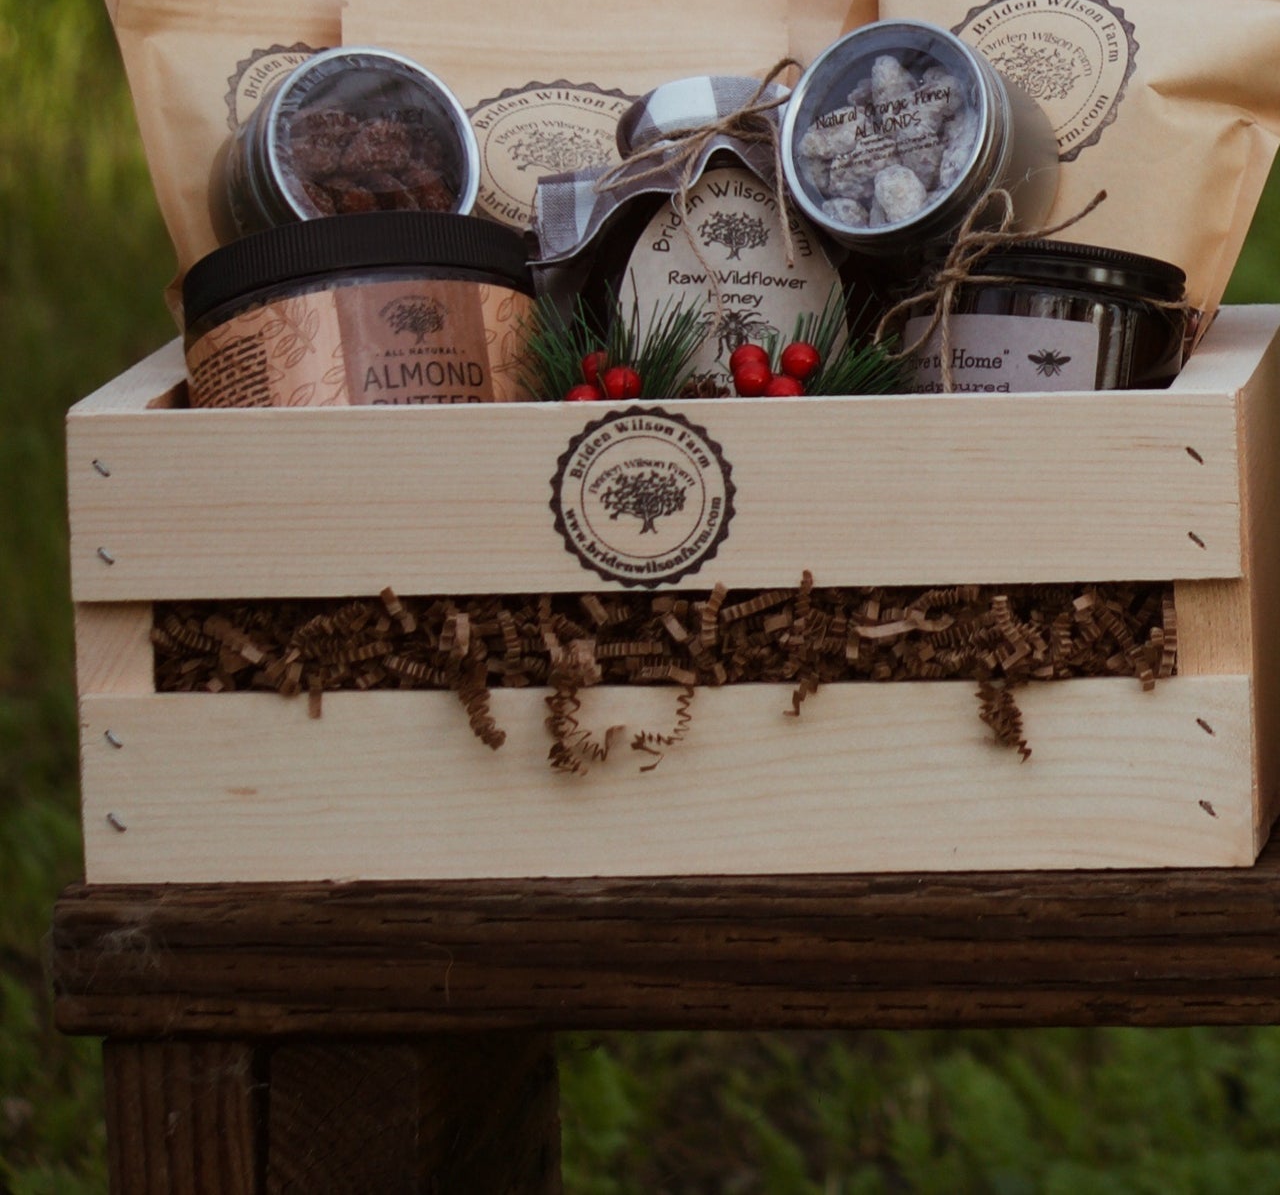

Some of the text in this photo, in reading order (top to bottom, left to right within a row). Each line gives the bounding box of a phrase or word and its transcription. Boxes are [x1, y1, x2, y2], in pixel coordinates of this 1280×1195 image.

[972, 0, 1038, 36] Briden
[1101, 22, 1119, 63] Farm
[244, 59, 282, 100] Briden
[475, 97, 529, 130] Briden
[536, 90, 606, 109] Wilson
[815, 86, 952, 132] Natural Orange Honey
[854, 111, 923, 141] ALMONDS
[707, 180, 776, 212] Wilson
[668, 270, 808, 290] Raw Wildflower
[386, 346, 458, 358] ALL NATURAL
[951, 348, 1010, 370] Home"
[363, 361, 484, 393] ALMOND
[569, 408, 711, 480] Briden Wilson Farm
[564, 495, 722, 574] www.bridenwilsonfarm.com
